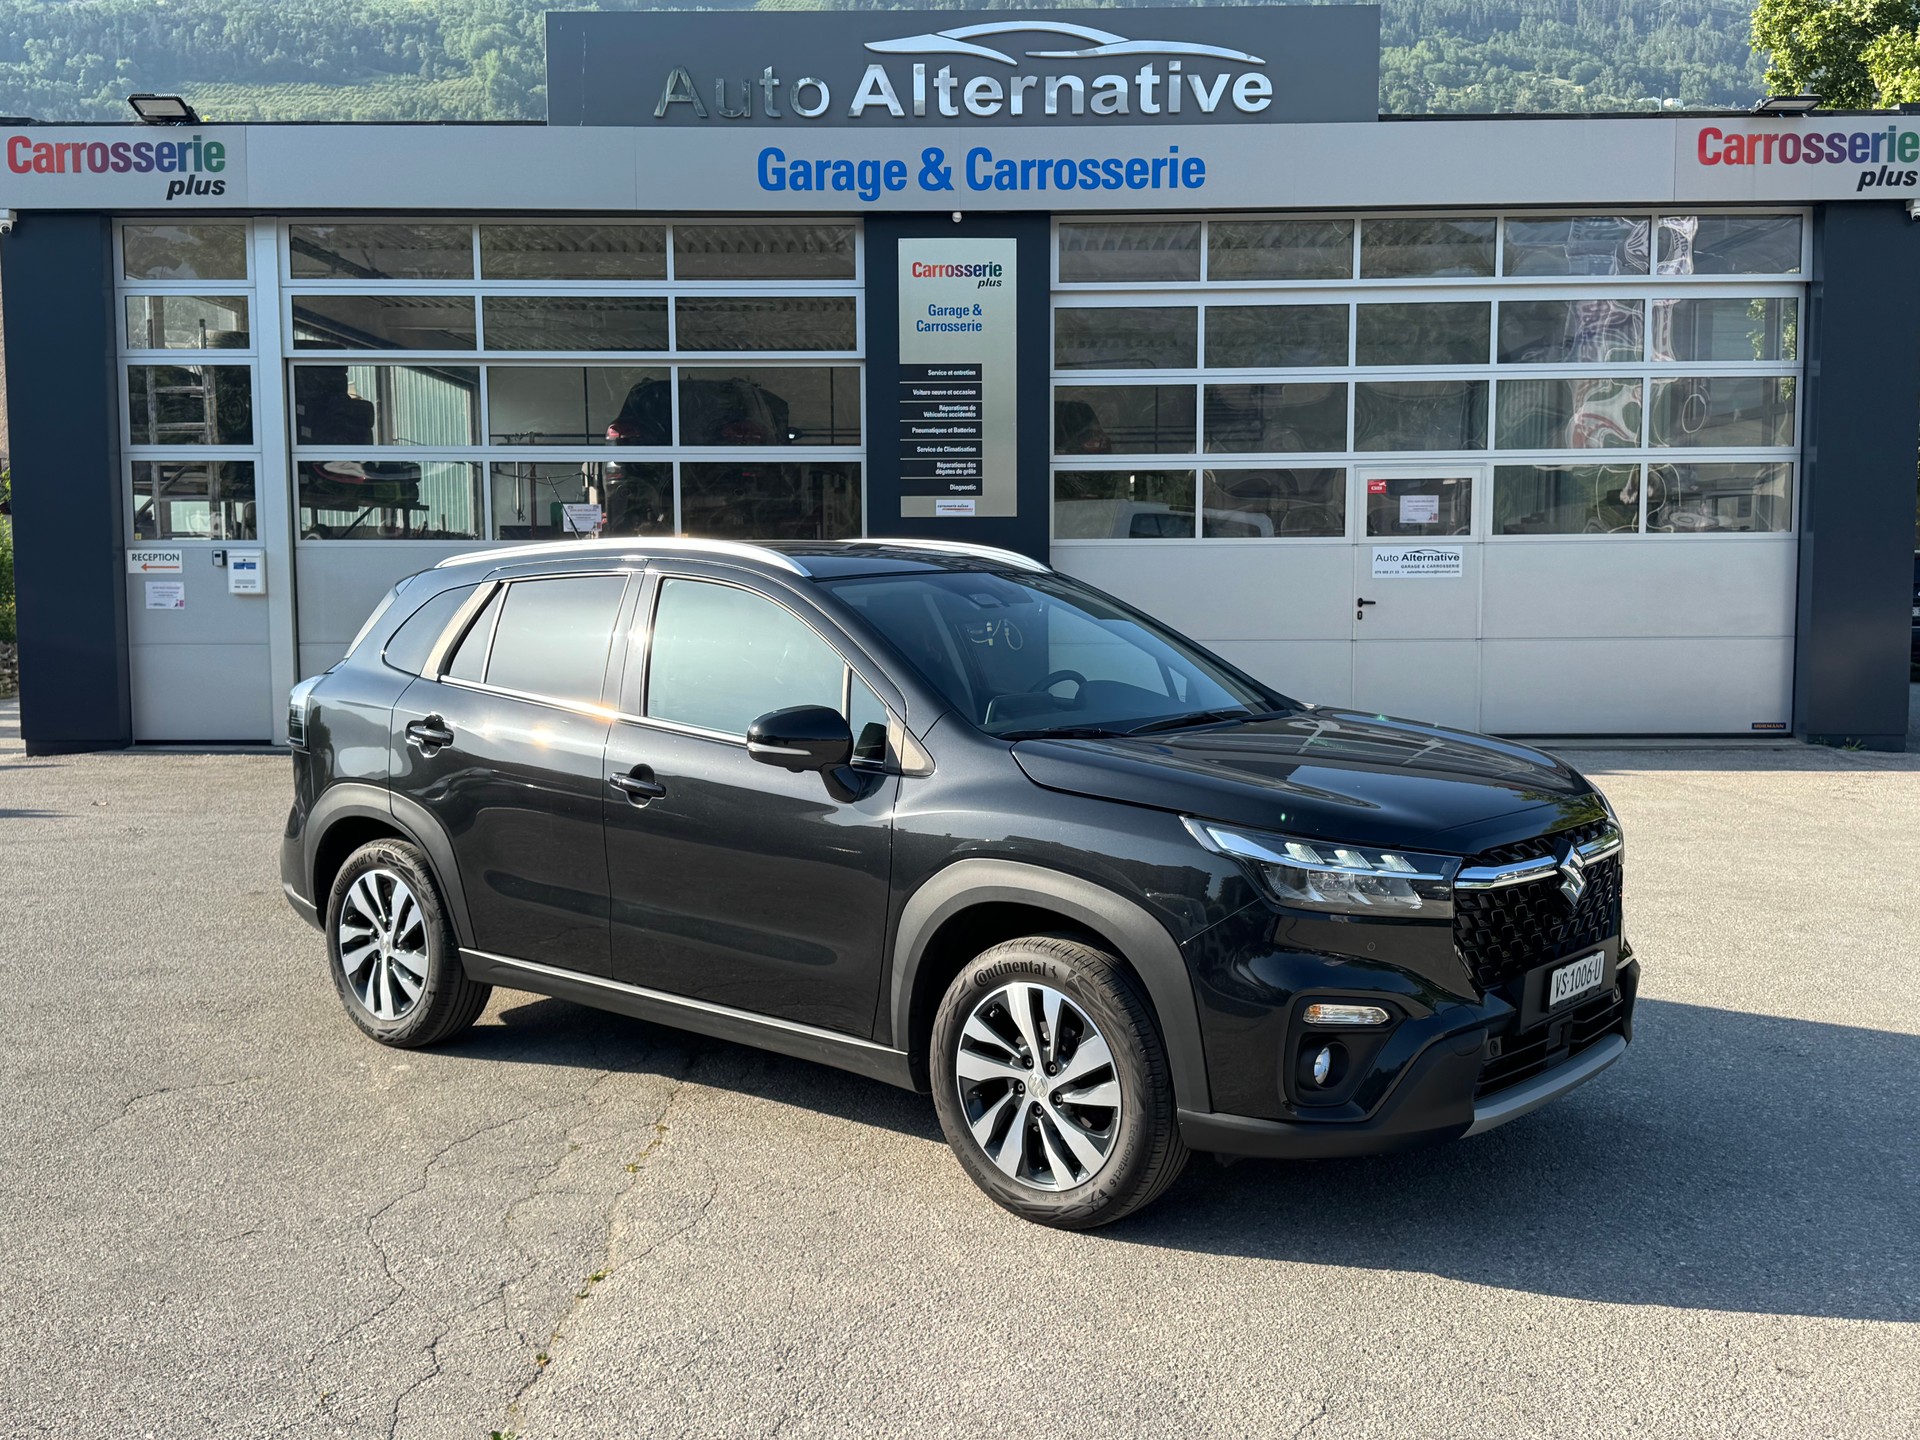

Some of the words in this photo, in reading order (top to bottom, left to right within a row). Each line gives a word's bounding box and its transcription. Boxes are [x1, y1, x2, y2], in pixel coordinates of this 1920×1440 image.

[653, 64, 831, 119] Auto
[847, 60, 1274, 119] Alternative
[7, 134, 226, 174] Carrosserie
[1697, 125, 1920, 166] Carrosserie
[757, 146, 908, 202] Garage
[918, 147, 956, 192] &
[966, 145, 1207, 192] Carrosserie
[1856, 164, 1919, 192] plus
[165, 174, 226, 201] plus
[911, 261, 1003, 279] Carrosserie
[977, 277, 1003, 290] plus
[928, 303, 970, 319] Garage
[972, 303, 983, 317] &
[916, 319, 983, 333] Carrosserie
[938, 404, 968, 412] Réparations
[911, 427, 947, 435] Pneumatiques
[949, 484, 976, 492] Diagnostic
[131, 553, 180, 562] RECEPTION
[1375, 554, 1399, 562] Auto
[1401, 553, 1460, 562] Alternative
[333, 853, 368, 896] Continental
[973, 960, 1047, 988] Continental
[1113, 1123, 1139, 1181] EcoContact
[1108, 1178, 1118, 1188] 6
